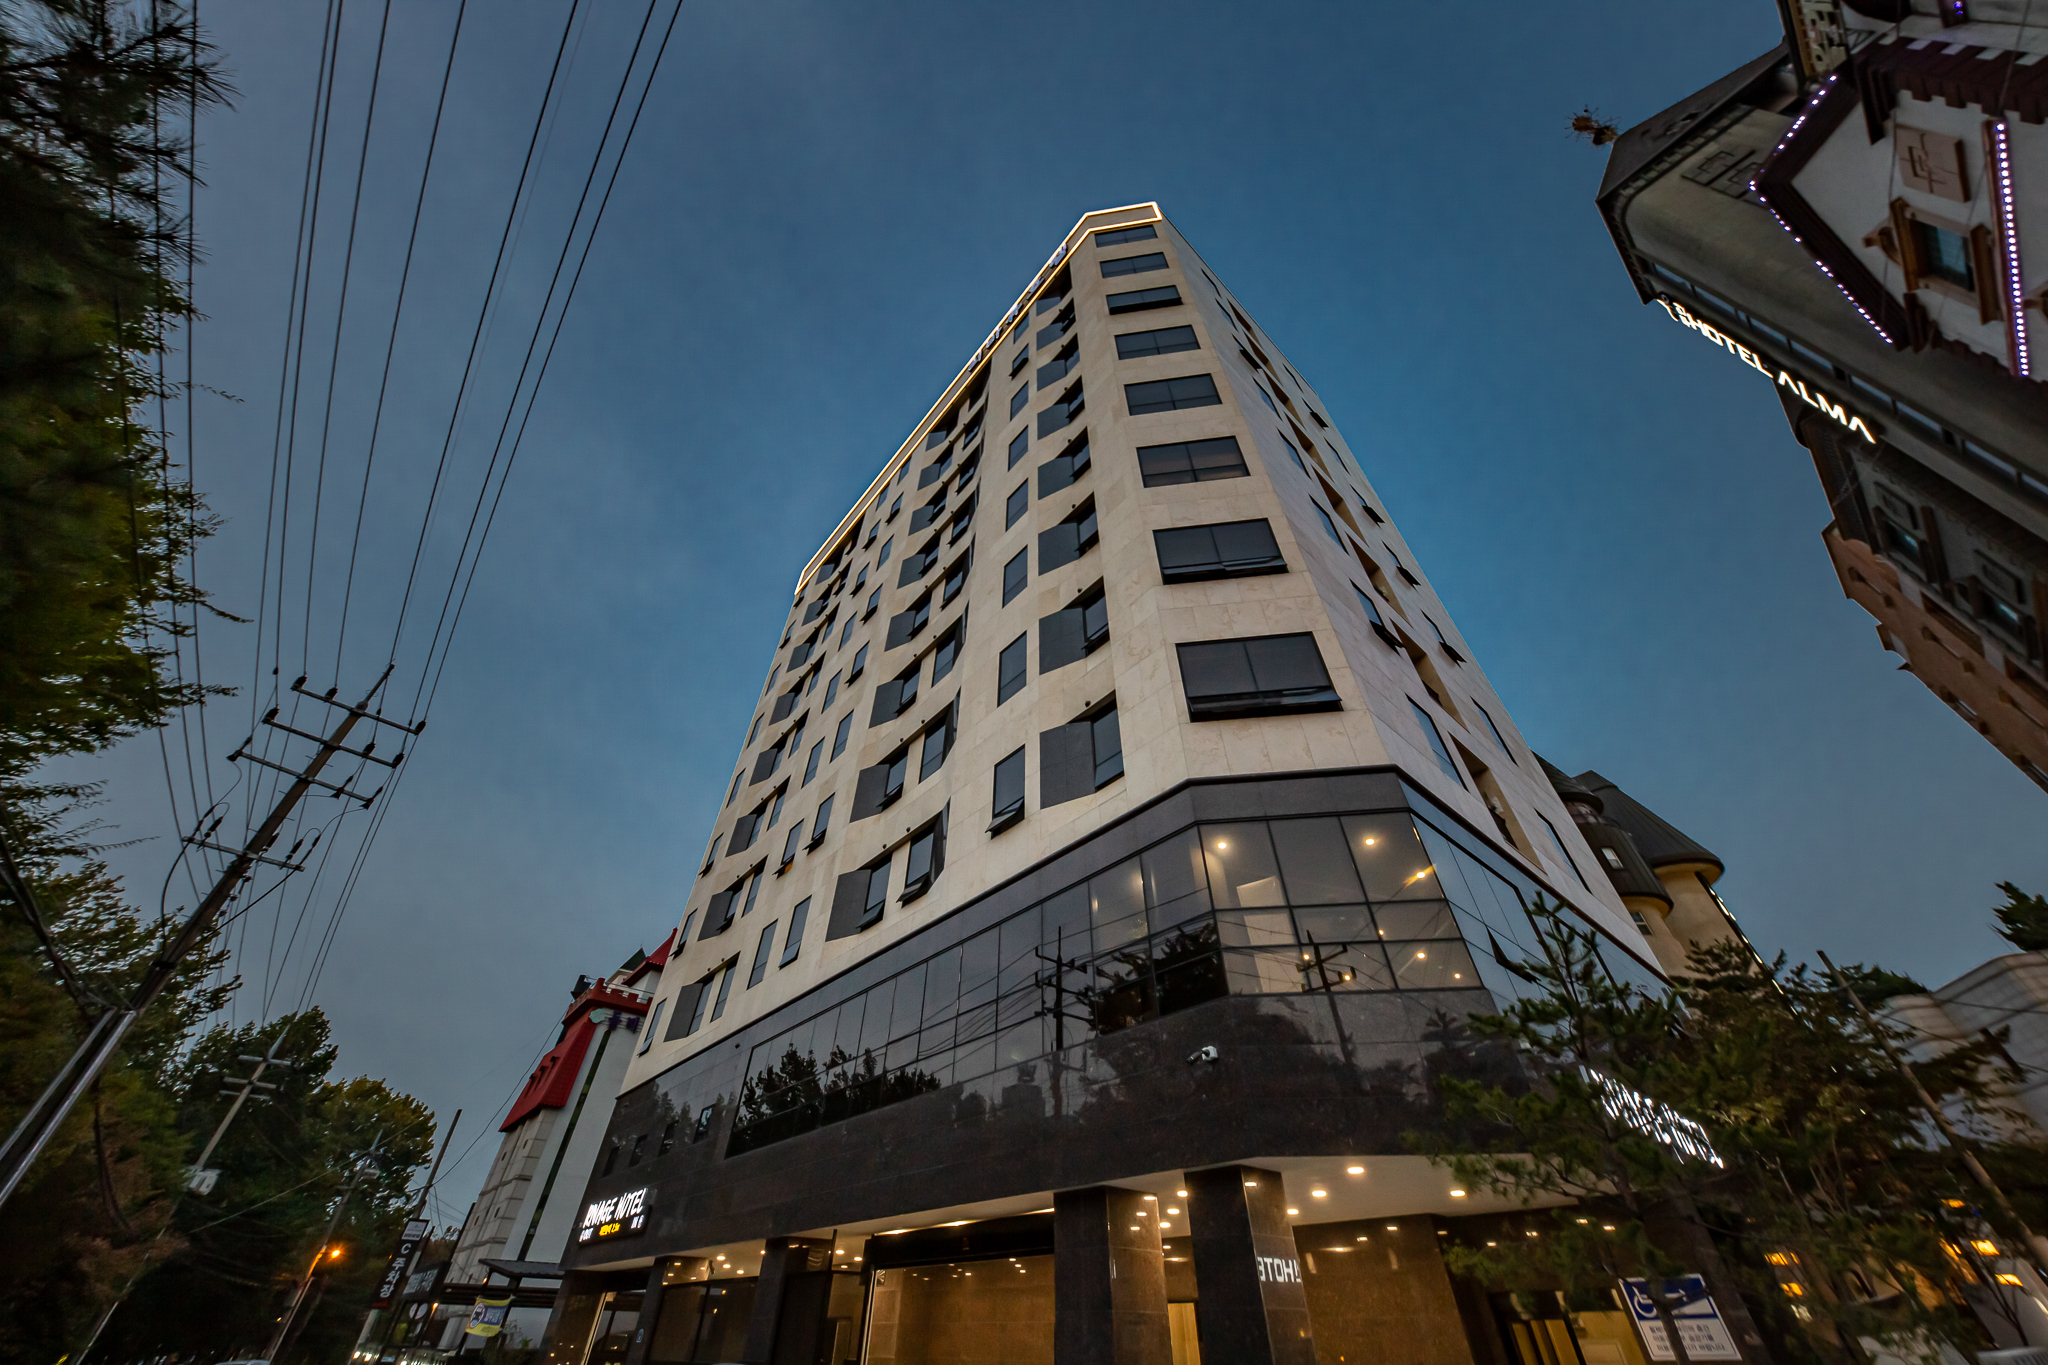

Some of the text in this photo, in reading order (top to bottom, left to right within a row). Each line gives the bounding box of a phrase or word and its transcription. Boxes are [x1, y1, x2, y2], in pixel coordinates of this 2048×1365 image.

[1686, 313, 1773, 378] HOTEL
[614, 1187, 648, 1220] HOTEL
[380, 1257, 405, 1298] 주차장
